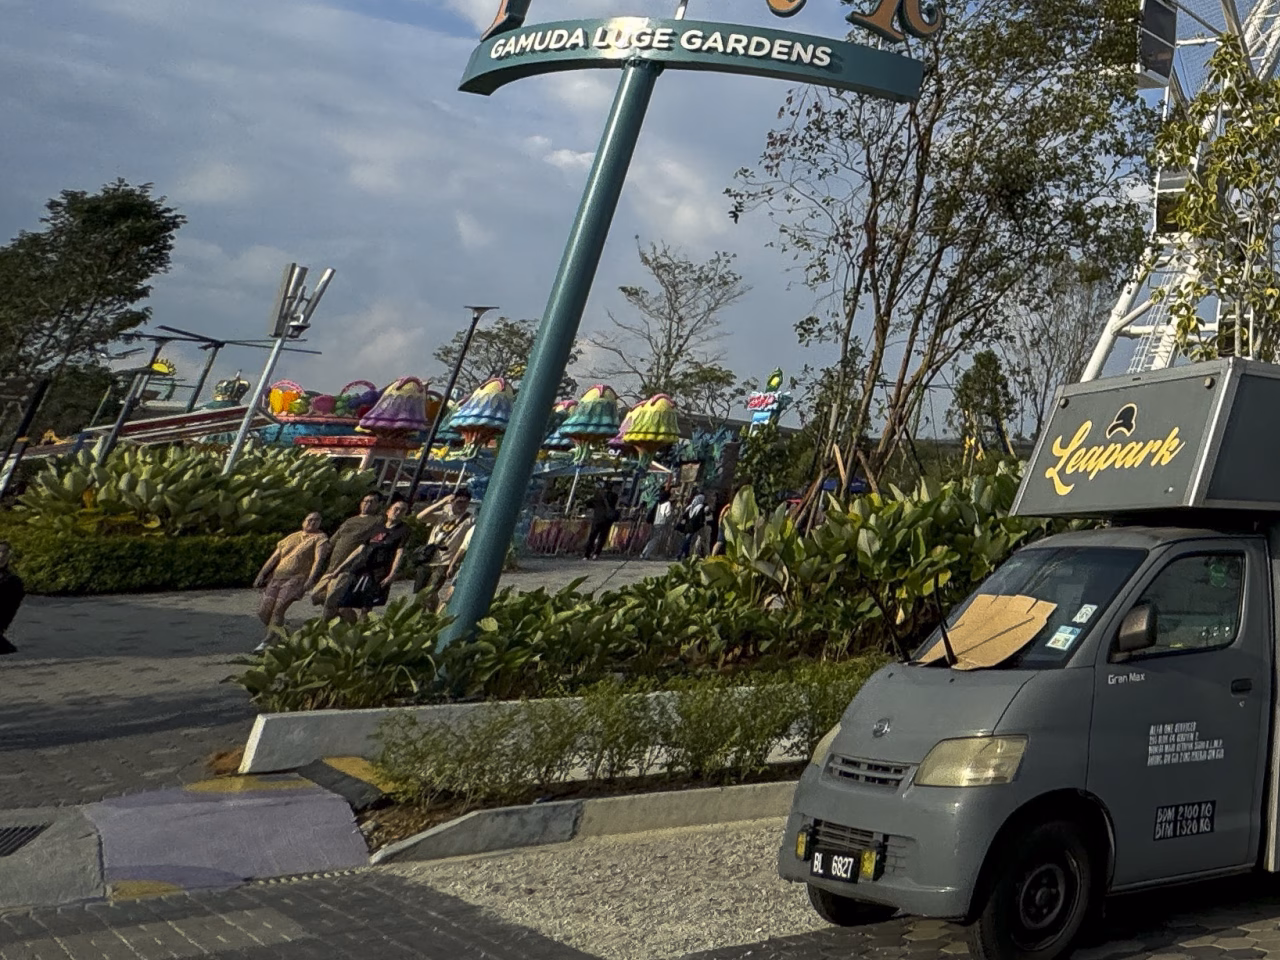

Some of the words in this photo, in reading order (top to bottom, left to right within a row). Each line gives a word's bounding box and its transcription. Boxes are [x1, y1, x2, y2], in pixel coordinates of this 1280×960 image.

[490, 28, 584, 59] GAMUDA
[592, 27, 673, 50] LUGE
[680, 28, 832, 67] GARDENS
[1045, 420, 1186, 496] Leapark
[1108, 674, 1128, 685] Gran
[1129, 672, 1145, 682] Max
[1177, 804, 1199, 820] 2100
[1201, 802, 1213, 817] KG
[1199, 817, 1211, 832] KG
[813, 852, 824, 874] BL
[831, 855, 854, 879] 6827
